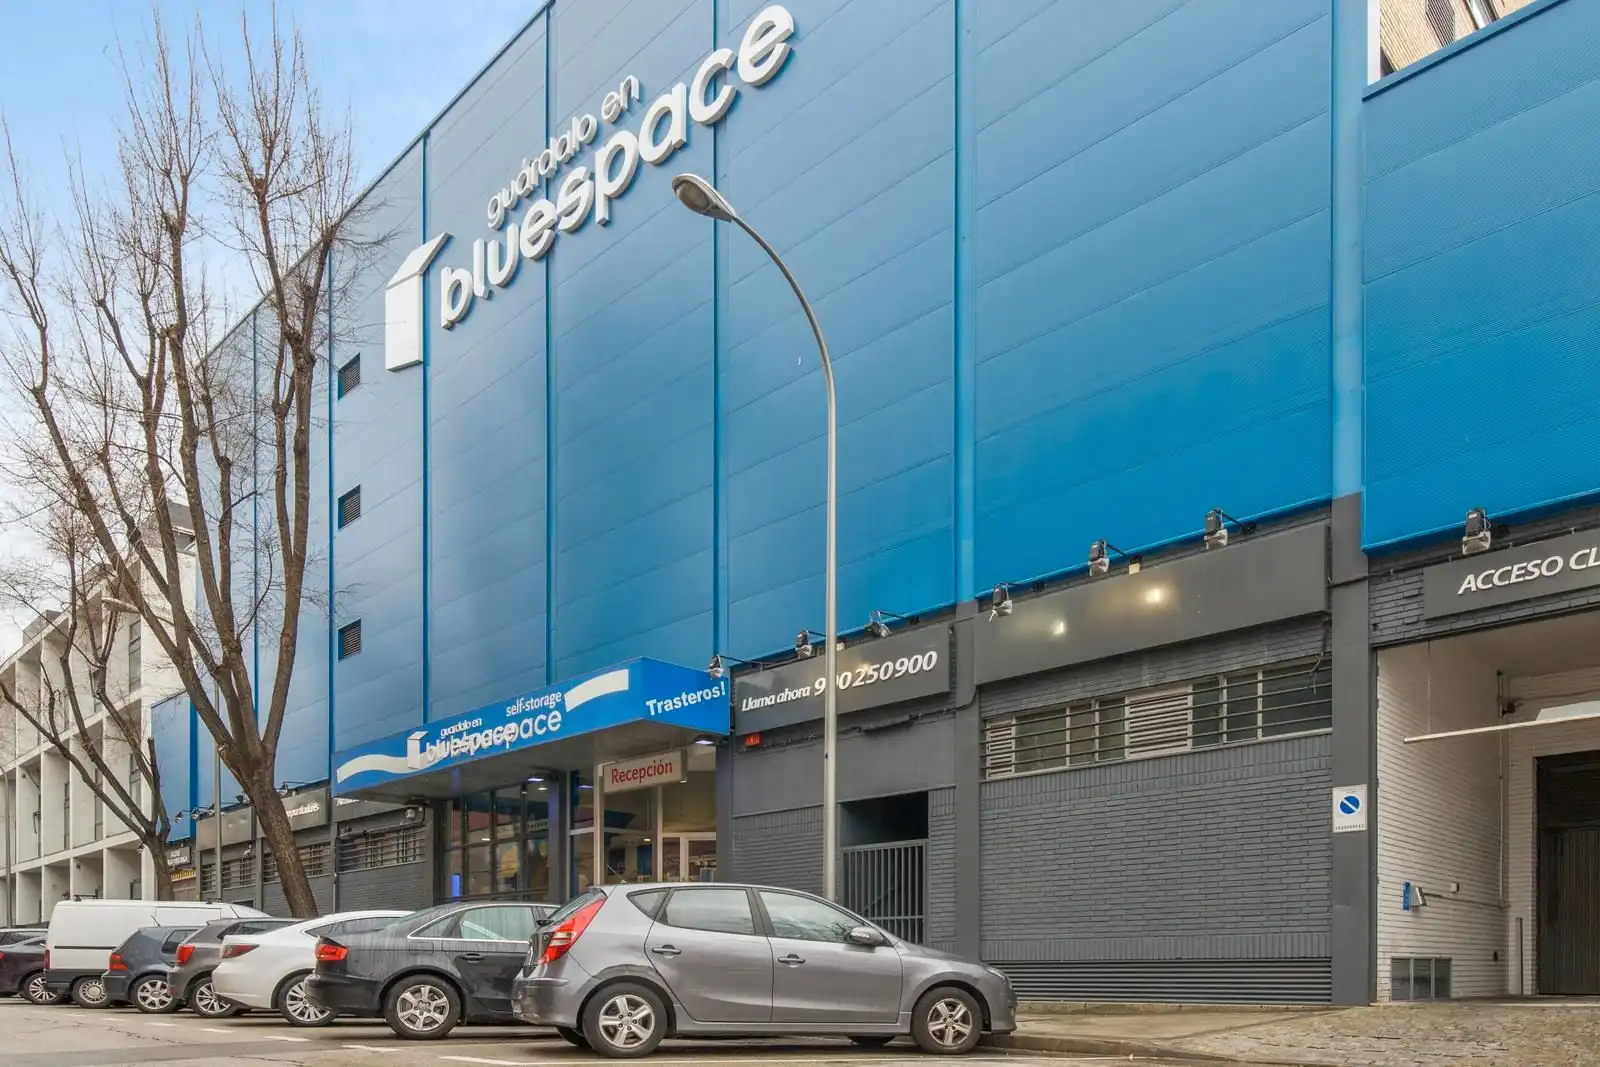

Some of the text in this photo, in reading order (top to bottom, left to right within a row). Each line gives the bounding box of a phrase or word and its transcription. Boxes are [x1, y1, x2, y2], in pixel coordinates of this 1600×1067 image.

[601, 75, 640, 124] en
[441, 4, 795, 329] bluespace
[1457, 547, 1600, 595] ACCESO CL
[506, 691, 562, 717] self-storage
[646, 681, 726, 716] Trasteros!
[741, 694, 775, 712] Llama
[777, 686, 811, 704] ahora
[471, 717, 482, 728] en
[611, 756, 673, 785] Recepción
